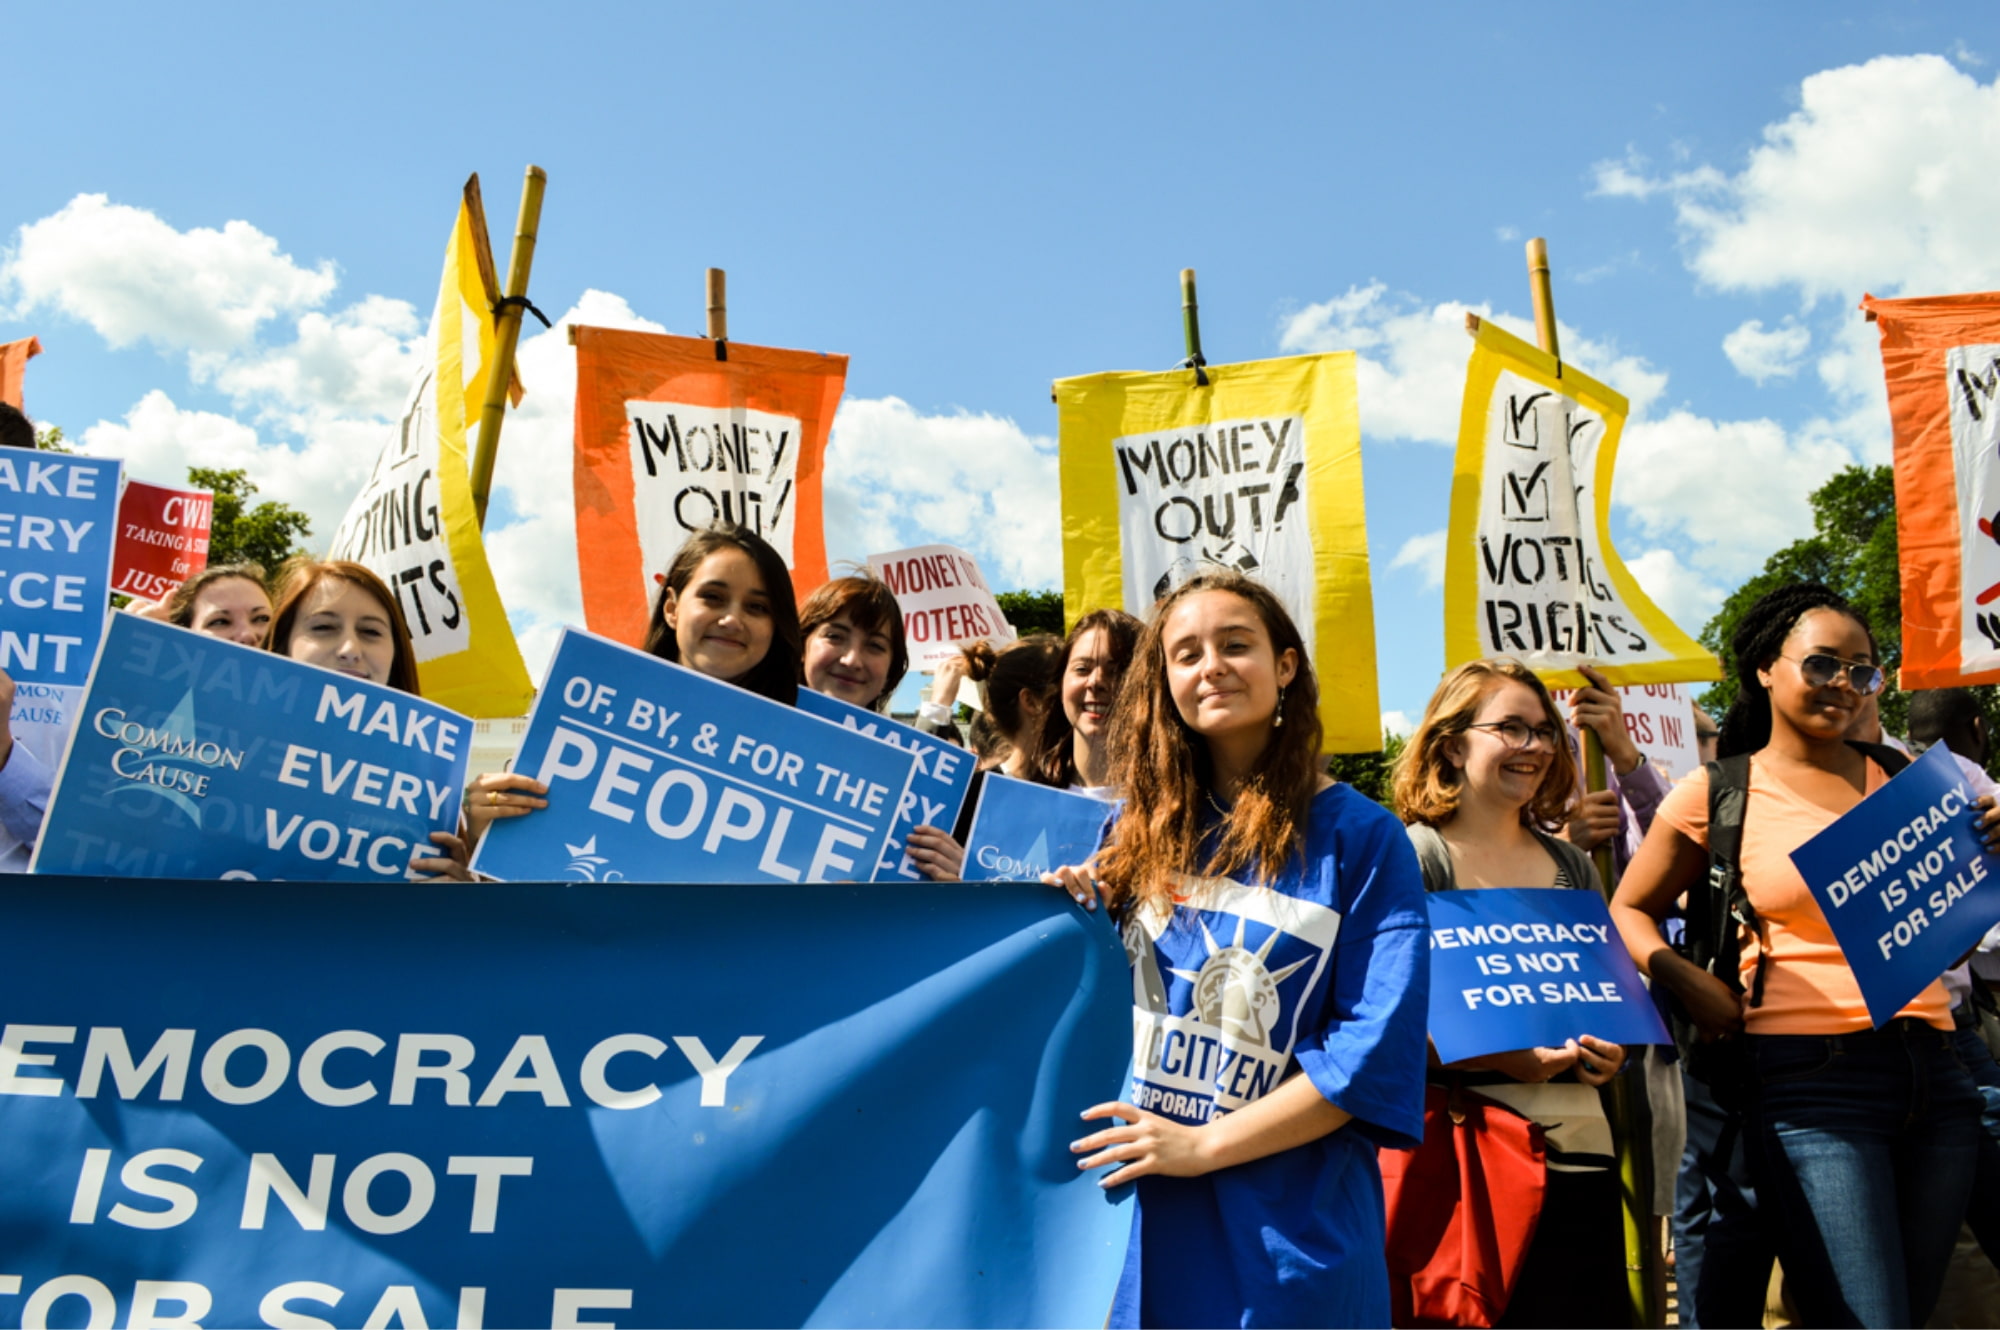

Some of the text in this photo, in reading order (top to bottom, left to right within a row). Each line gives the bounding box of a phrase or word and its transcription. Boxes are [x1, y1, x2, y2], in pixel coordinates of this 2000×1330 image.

[634, 414, 789, 484] MONEY
[1116, 419, 1292, 495] MONEY
[125, 524, 184, 550] TAKING
[674, 485, 792, 542] OUT!
[1155, 462, 1304, 543] OUT!
[171, 558, 191, 574] for
[883, 554, 962, 596] MONEY
[94, 707, 244, 770] COMMON
[315, 683, 460, 762] MAKE
[563, 676, 889, 816] OF, BY, & FOR THE
[111, 747, 211, 797] CAUSE
[278, 744, 451, 820] EVERY
[536, 725, 868, 882] PEOPLE
[266, 808, 441, 881] VOICE
[1826, 783, 1970, 909] DEMOCRACY
[1879, 837, 1956, 913] IS NOT
[1877, 856, 1989, 961] FOR SALE
[1462, 982, 1622, 1010] FOR SALE
[1476, 952, 1581, 976] IS NOT
[69, 1148, 534, 1235] IS NOT
